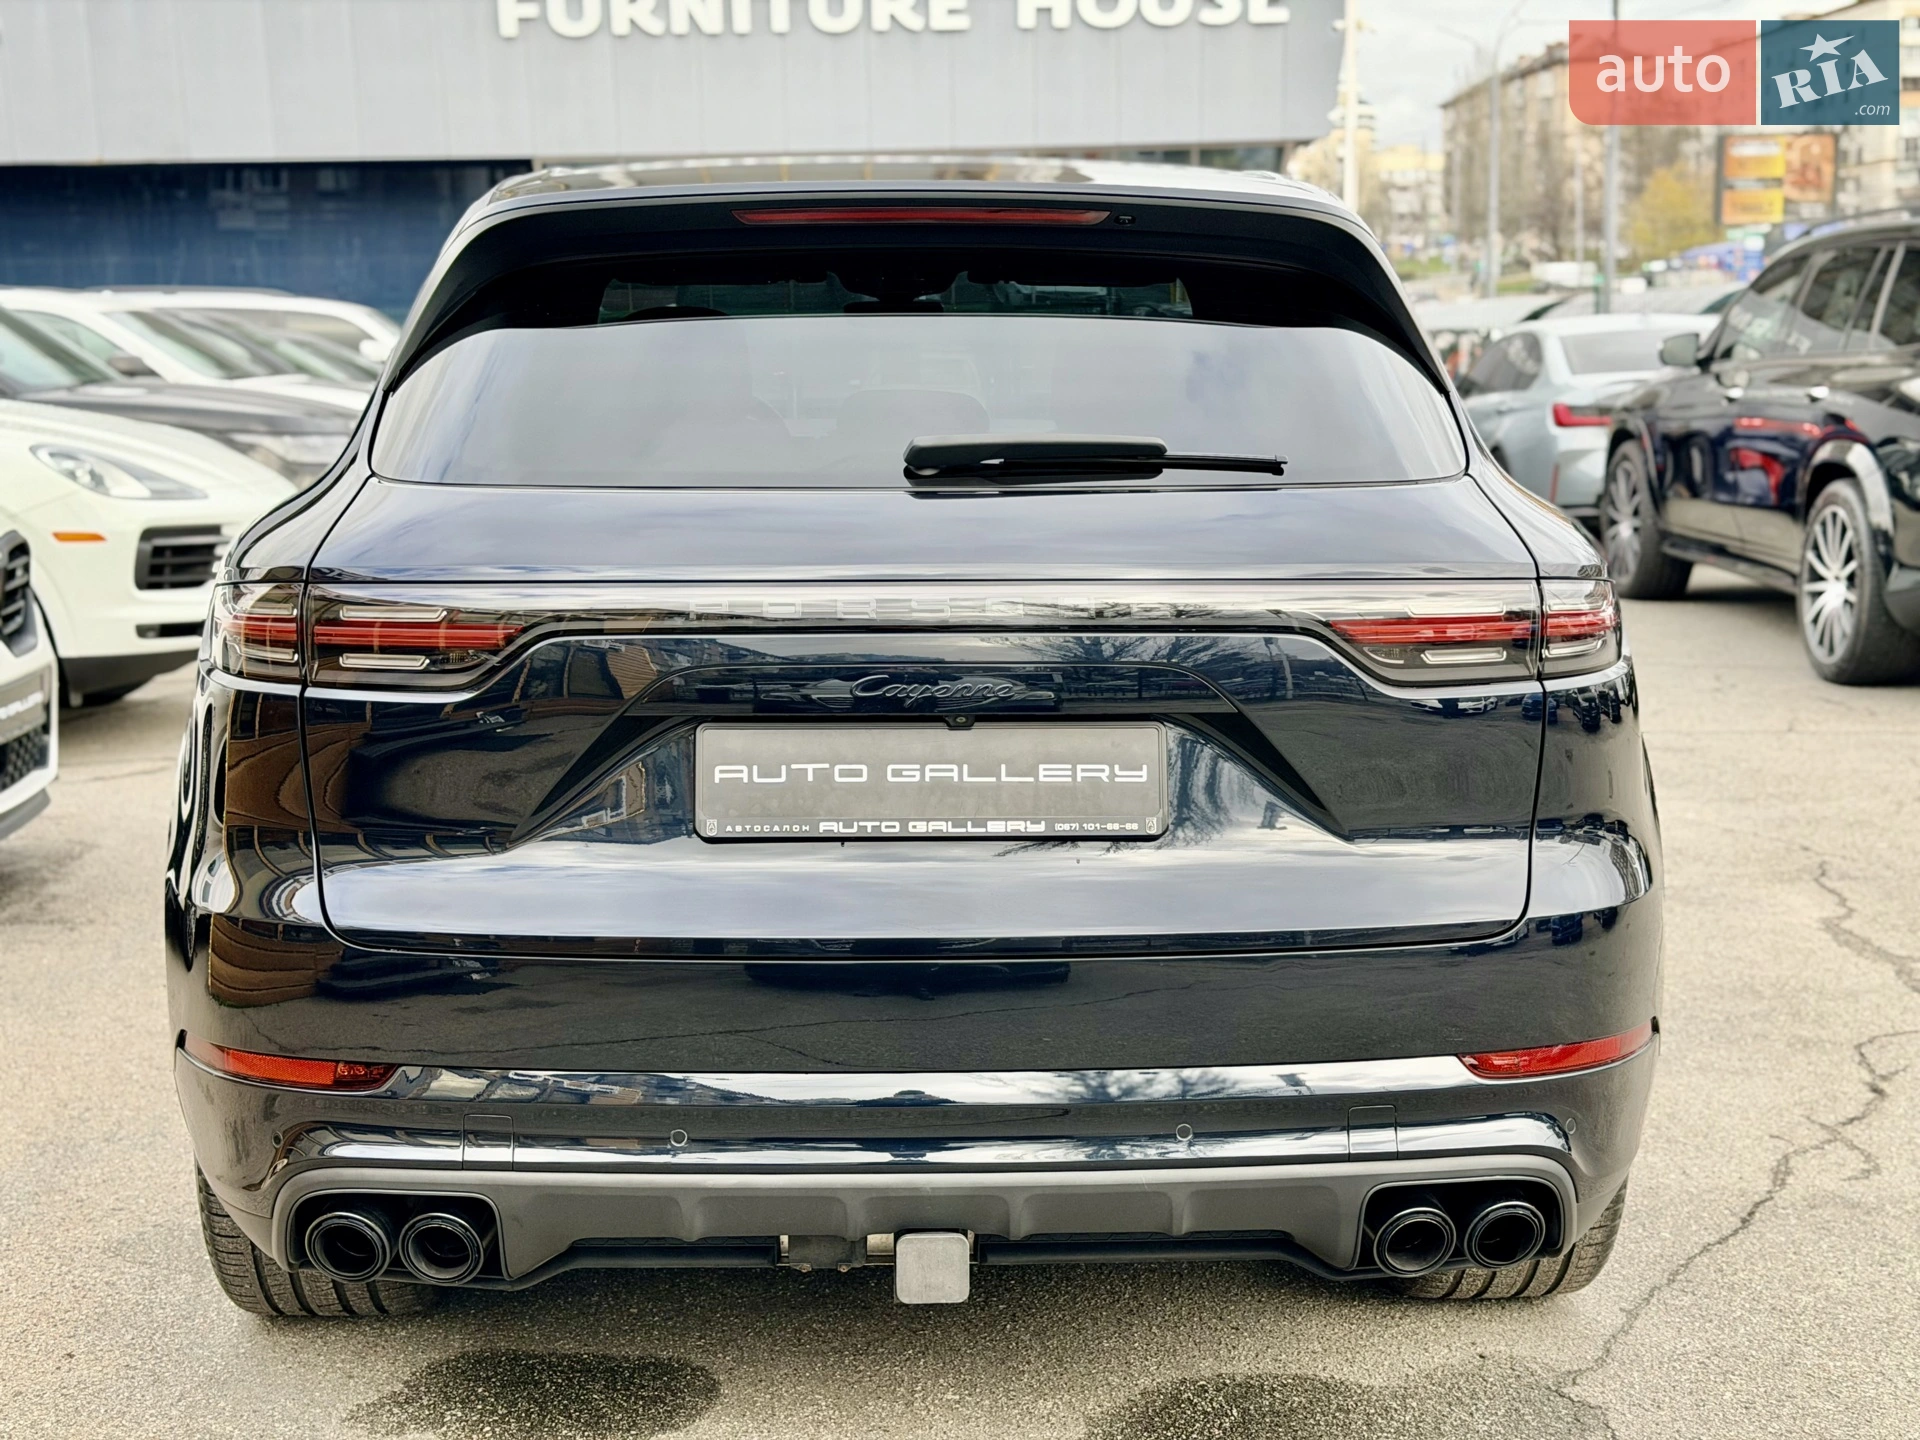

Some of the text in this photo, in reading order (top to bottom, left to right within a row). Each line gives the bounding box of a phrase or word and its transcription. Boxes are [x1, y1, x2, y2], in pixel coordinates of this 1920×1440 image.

[851, 674, 1016, 709] Cayenne
[714, 763, 1148, 784] AUTO GALLERY
[725, 824, 810, 833] АВТОСАЛОН
[819, 821, 901, 834] AUTO
[907, 820, 1046, 833] GALLERY
